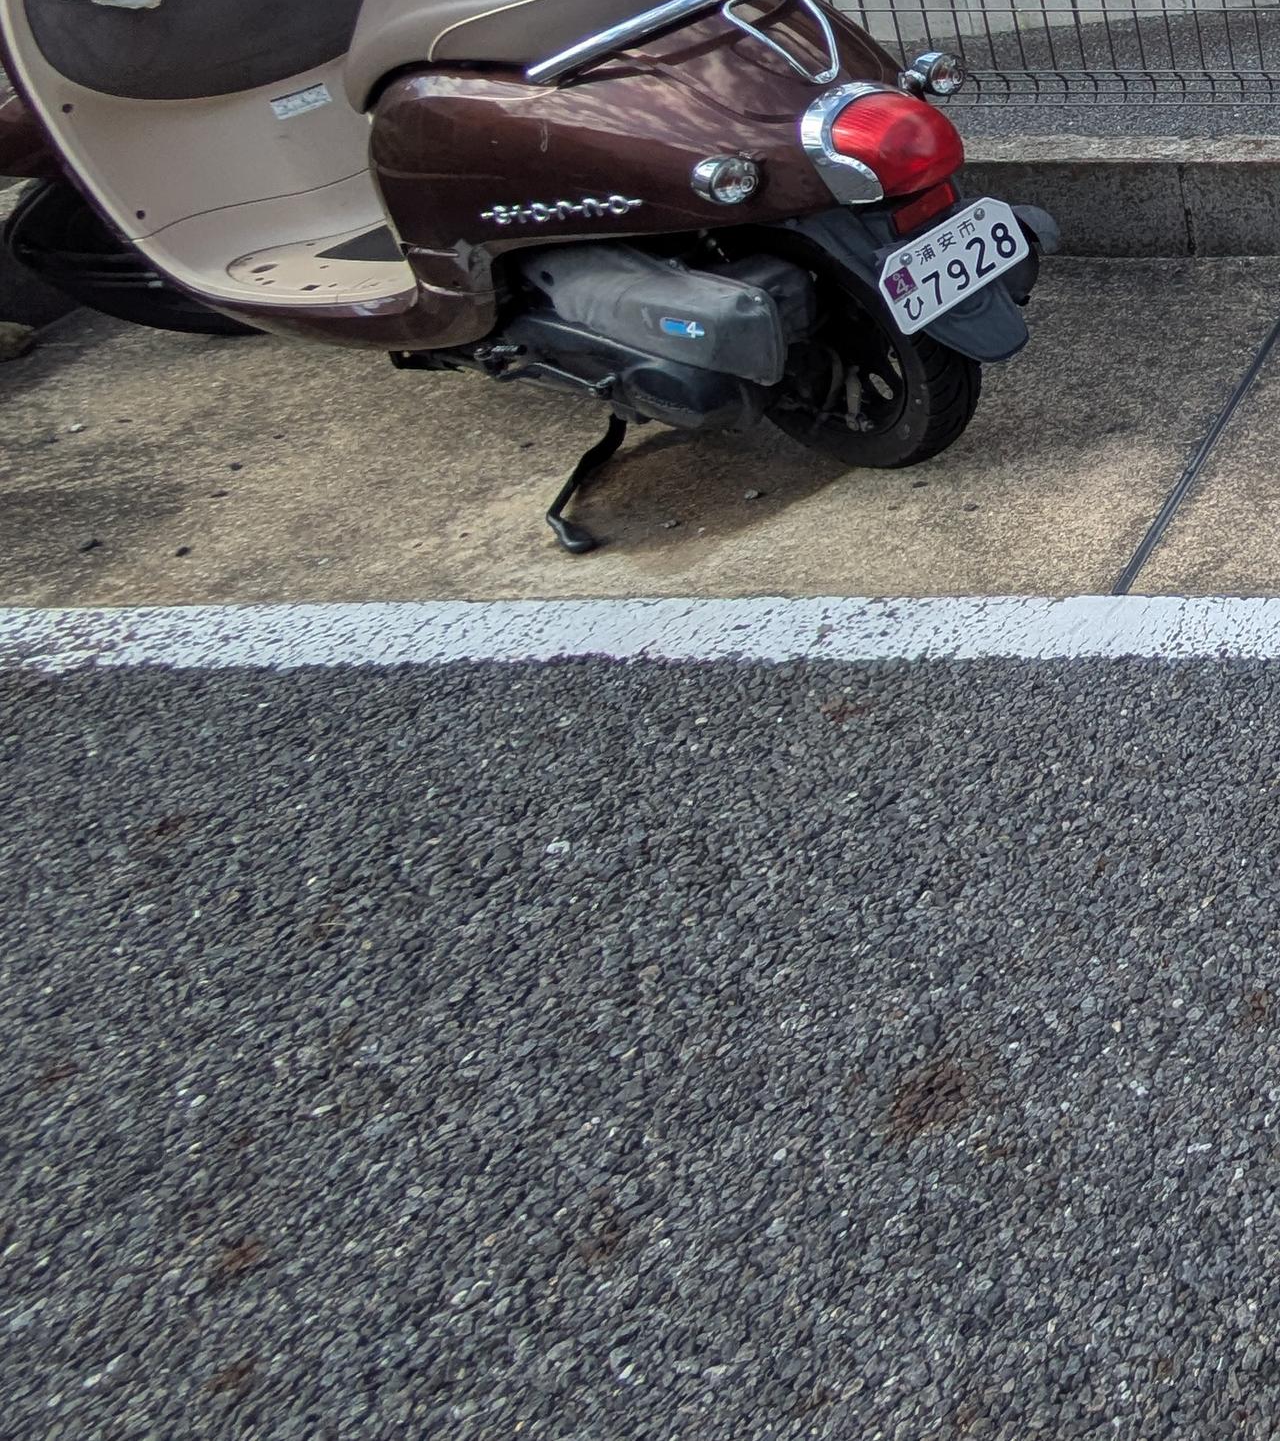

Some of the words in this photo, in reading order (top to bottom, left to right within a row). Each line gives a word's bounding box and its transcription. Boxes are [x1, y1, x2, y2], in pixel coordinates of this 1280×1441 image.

[903, 295, 924, 321] ひ
[921, 222, 1017, 306] 7928
[914, 218, 976, 266] 浦安市
